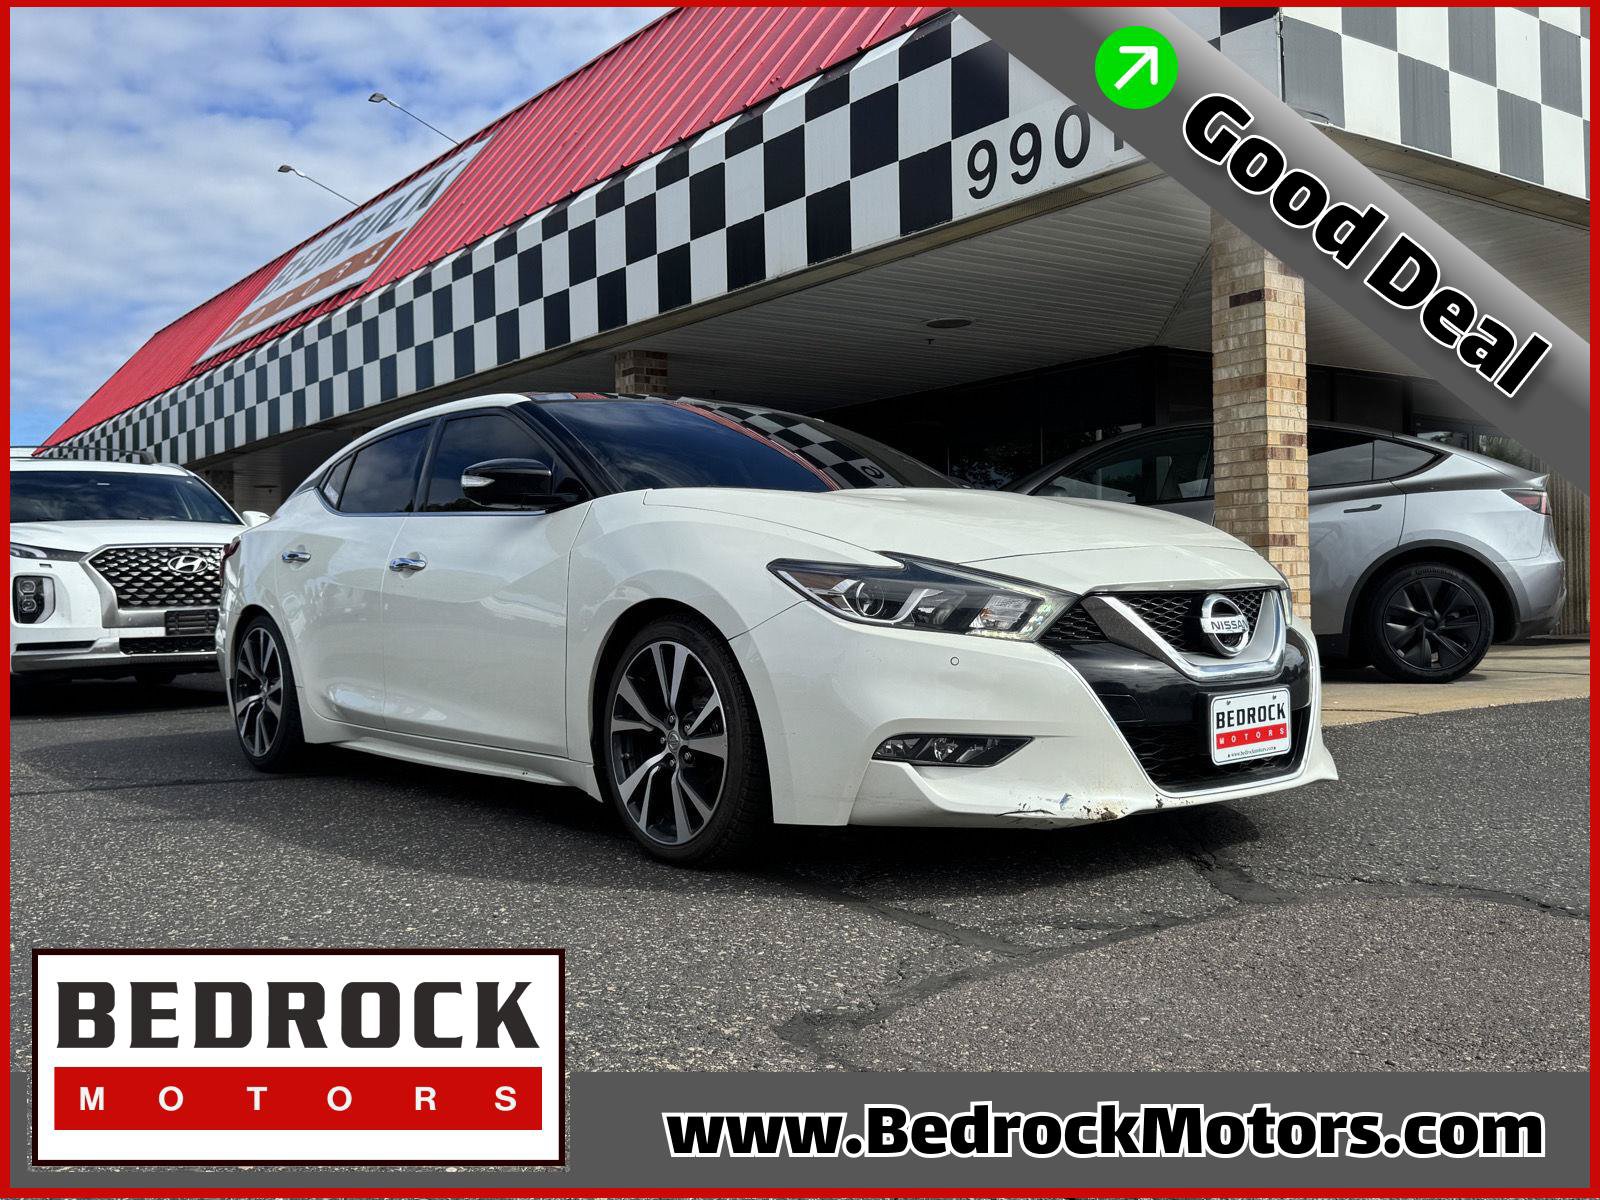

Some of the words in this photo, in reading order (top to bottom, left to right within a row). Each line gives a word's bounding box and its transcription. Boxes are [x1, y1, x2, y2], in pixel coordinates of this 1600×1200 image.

[967, 104, 1124, 199] 990
[252, 158, 467, 304] BEDROCK
[1211, 619, 1248, 631] NISSAN
[1216, 702, 1286, 729] BEDROCK
[1220, 727, 1284, 745] MOTORS
